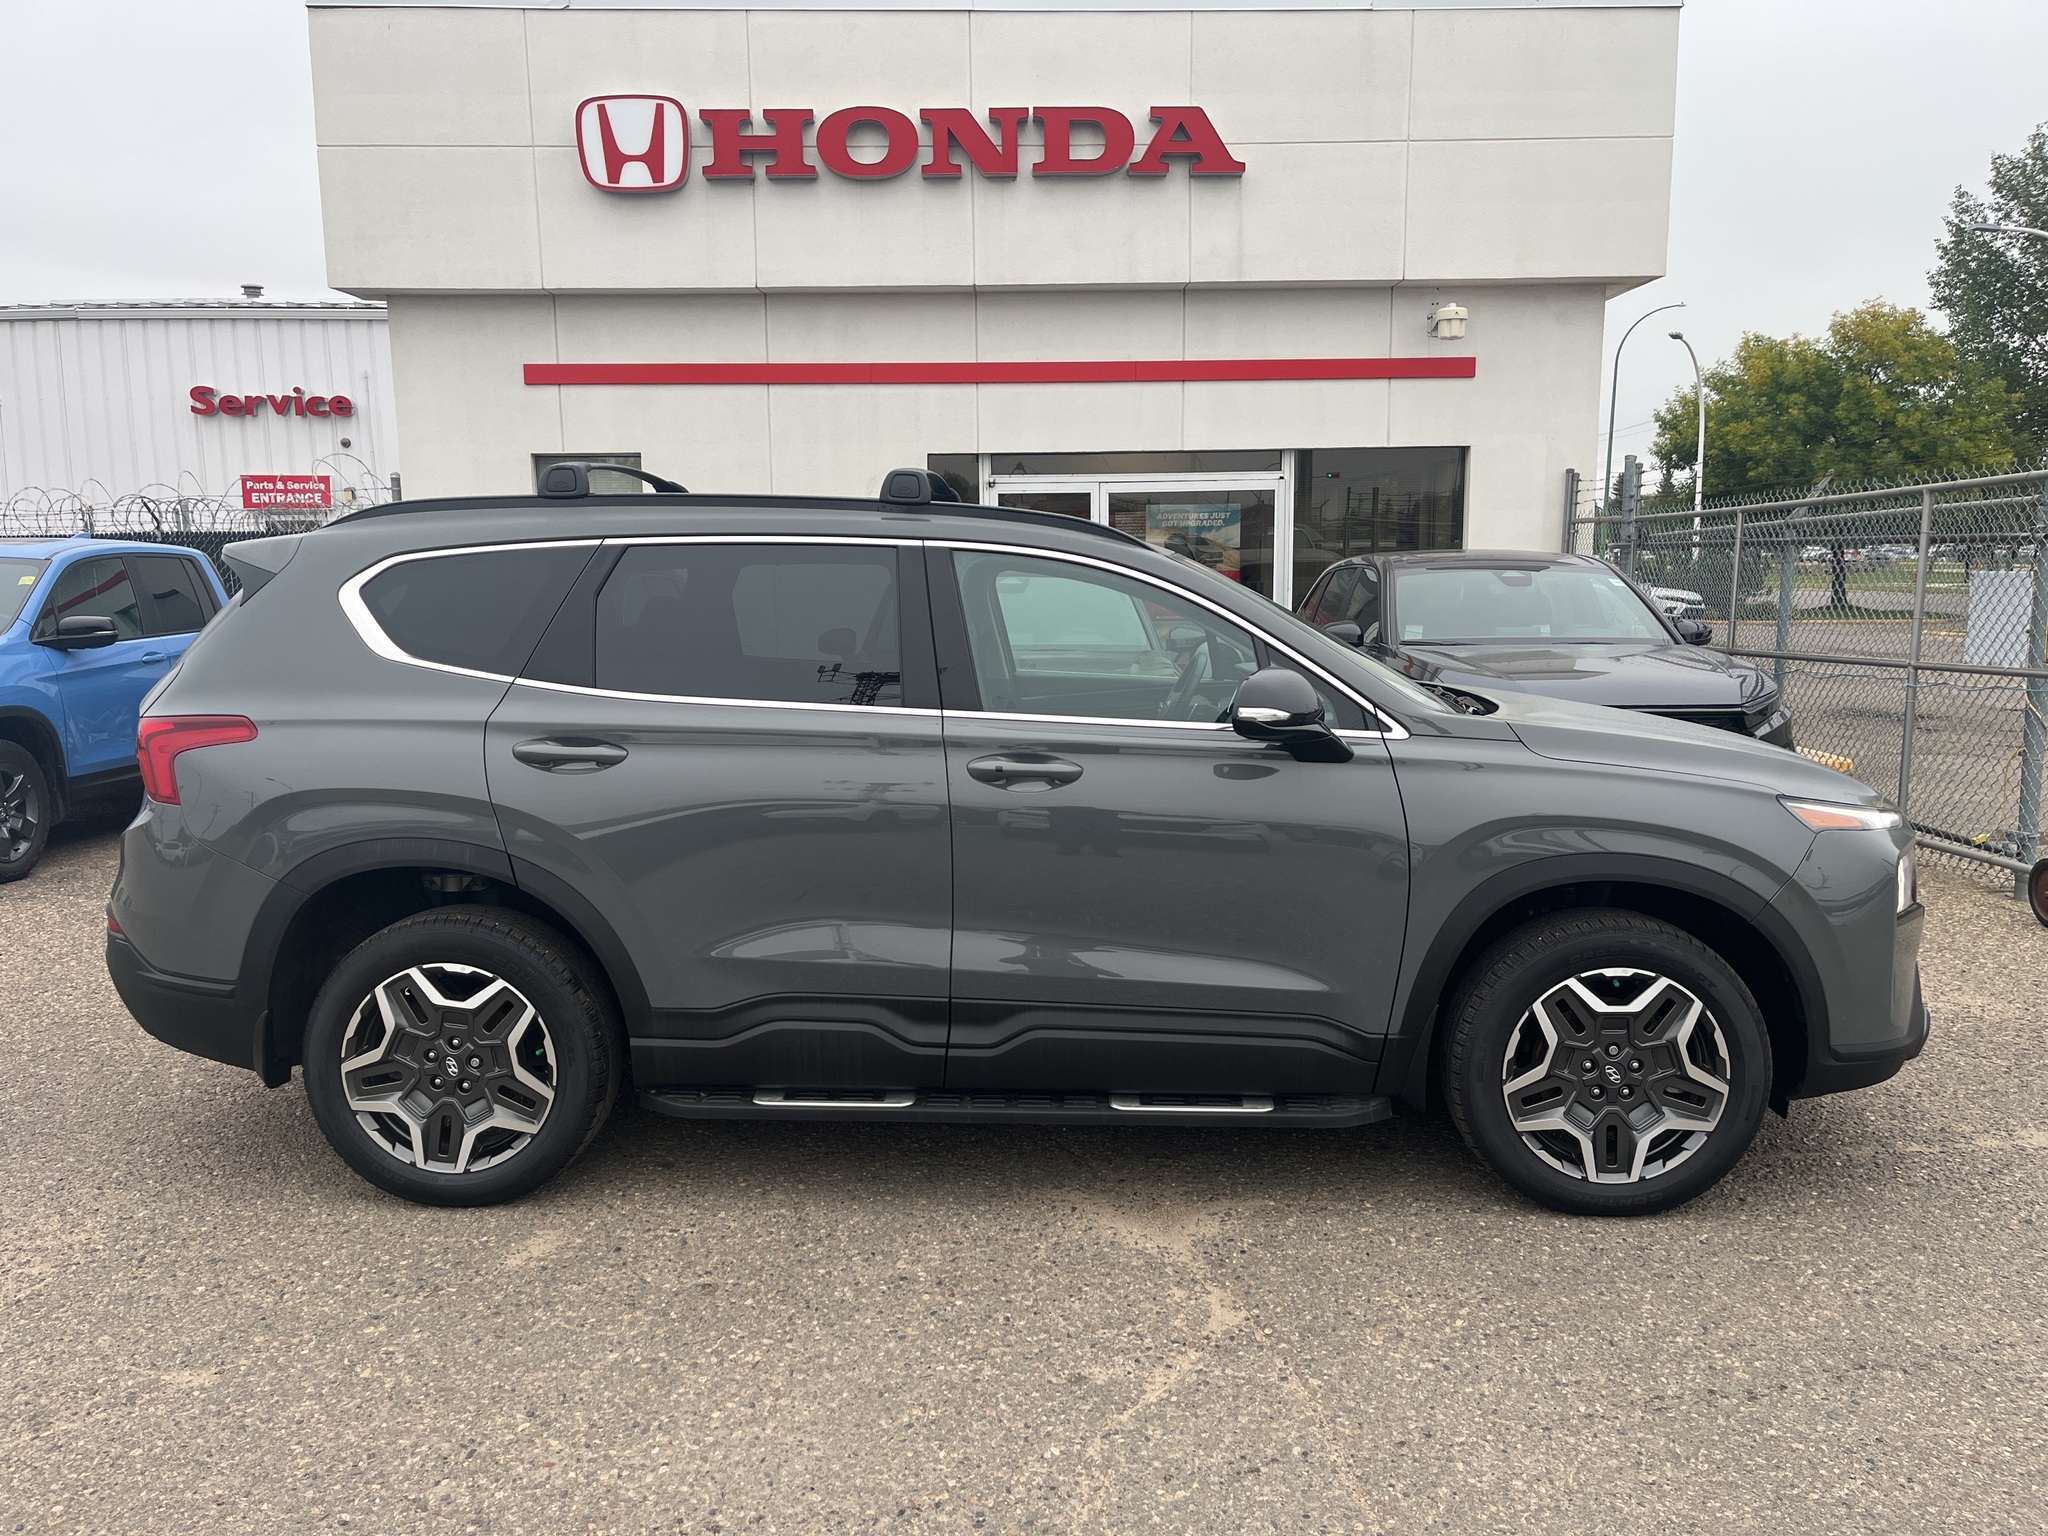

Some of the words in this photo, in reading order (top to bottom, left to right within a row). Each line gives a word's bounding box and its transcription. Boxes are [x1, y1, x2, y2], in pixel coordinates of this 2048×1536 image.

[700, 106, 1246, 180] HONDA
[189, 385, 353, 417] Service
[246, 481, 274, 490] Parts
[276, 481, 285, 490] &
[287, 481, 325, 490] Service
[251, 493, 322, 503] ENTRANCE
